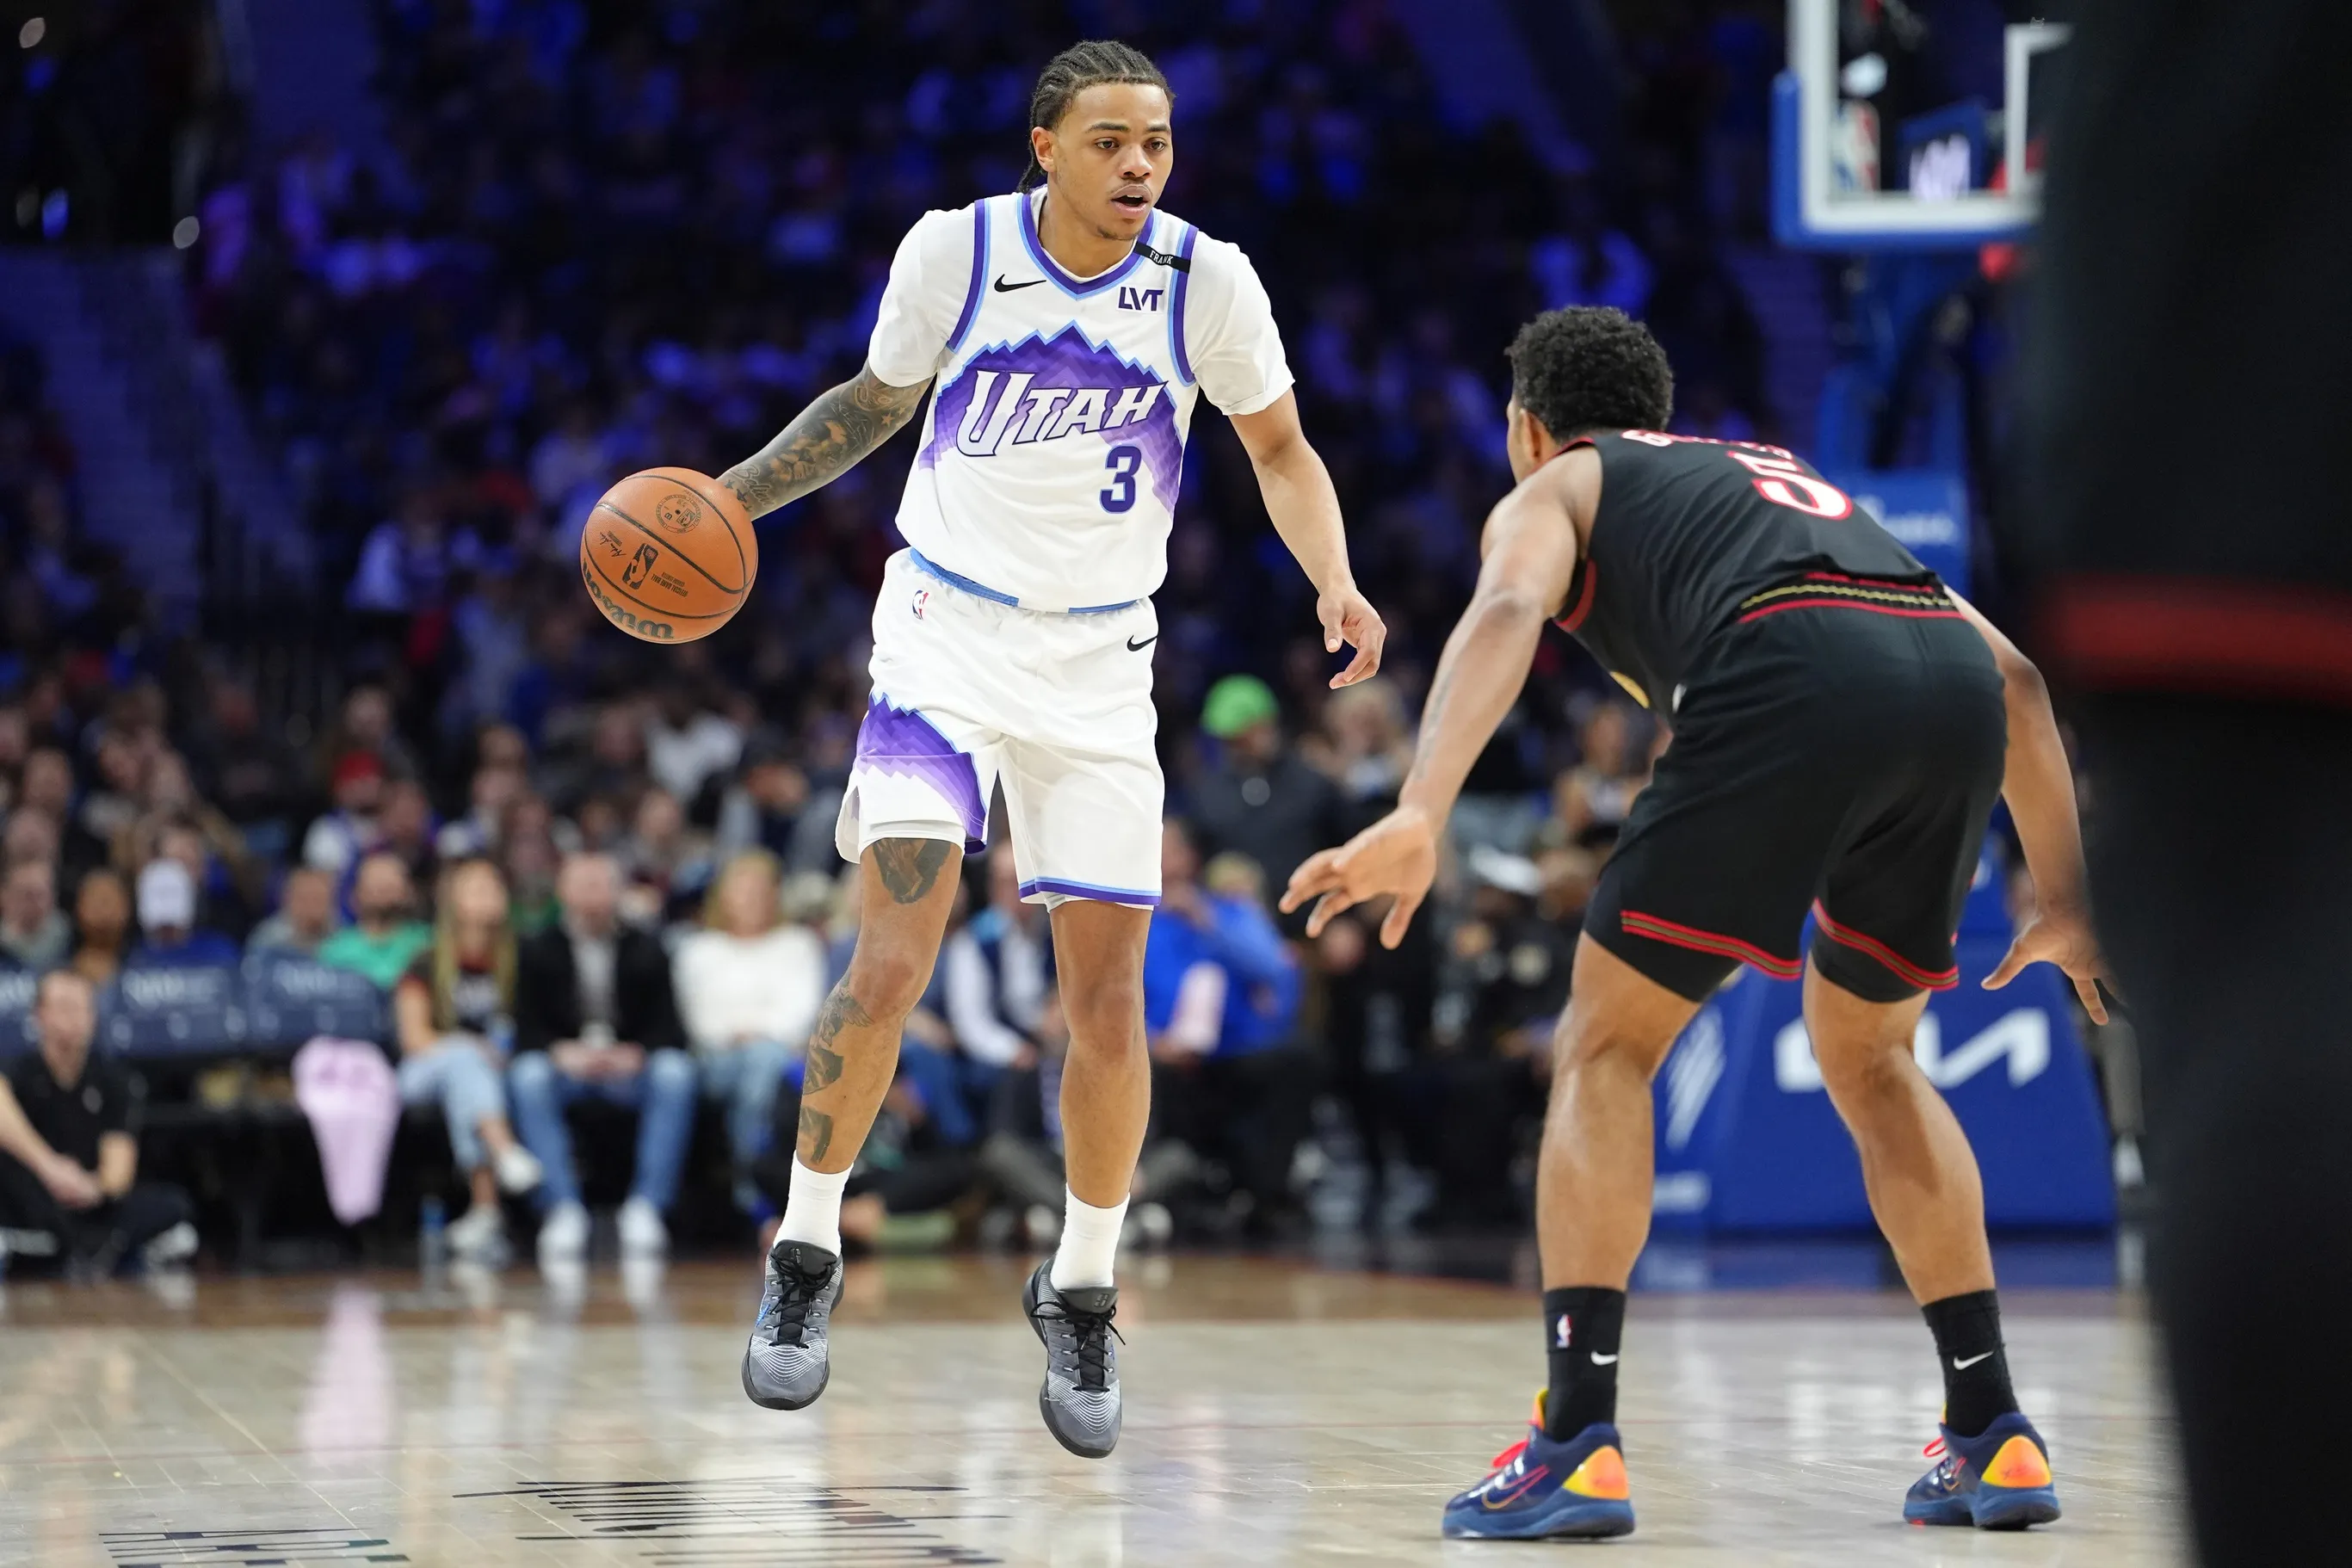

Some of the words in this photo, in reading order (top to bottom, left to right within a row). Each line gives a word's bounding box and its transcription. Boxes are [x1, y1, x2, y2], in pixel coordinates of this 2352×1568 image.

[1149, 250, 1174, 264] FRANK
[1118, 287, 1164, 312] LVT
[955, 369, 1170, 457] UTAH
[1100, 445, 1142, 515] 3
